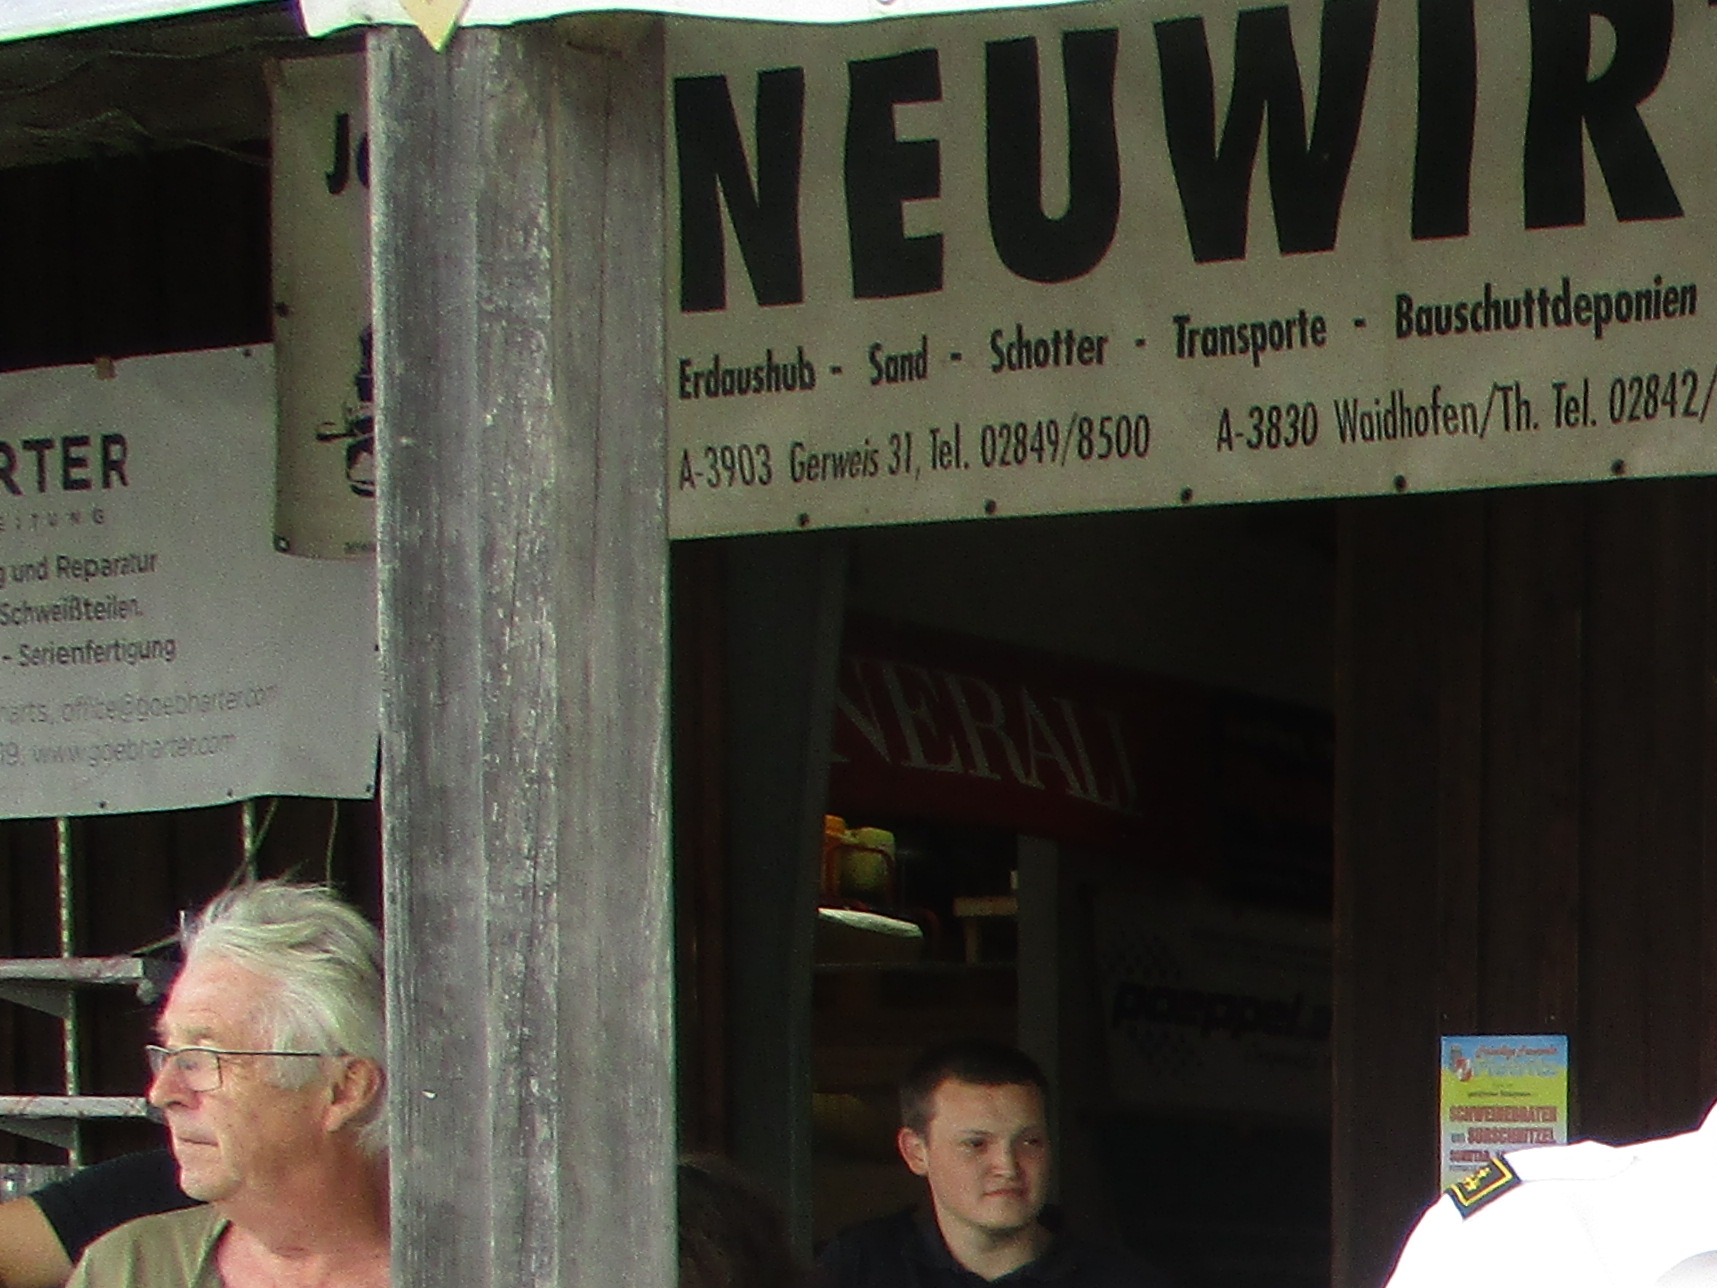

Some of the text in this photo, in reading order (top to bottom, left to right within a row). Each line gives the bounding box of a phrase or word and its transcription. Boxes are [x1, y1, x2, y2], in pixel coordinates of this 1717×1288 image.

[678, 346, 817, 402] Erdaushub
[868, 335, 929, 388] Sand
[990, 321, 1110, 375] Schotter
[1173, 308, 1328, 367] Transporte
[1395, 276, 1698, 340] Bauschuttdeponien
[679, 411, 1152, 492] A-3903 Gerweis 31, Tel. 02849/8500
[1216, 403, 1319, 454] A-3830
[1334, 380, 1540, 446] Waidhofen/Th.
[1552, 379, 1597, 431] Tel.
[56, 553, 158, 582] Reparatur
[19, 638, 177, 667] Serienfertigung
